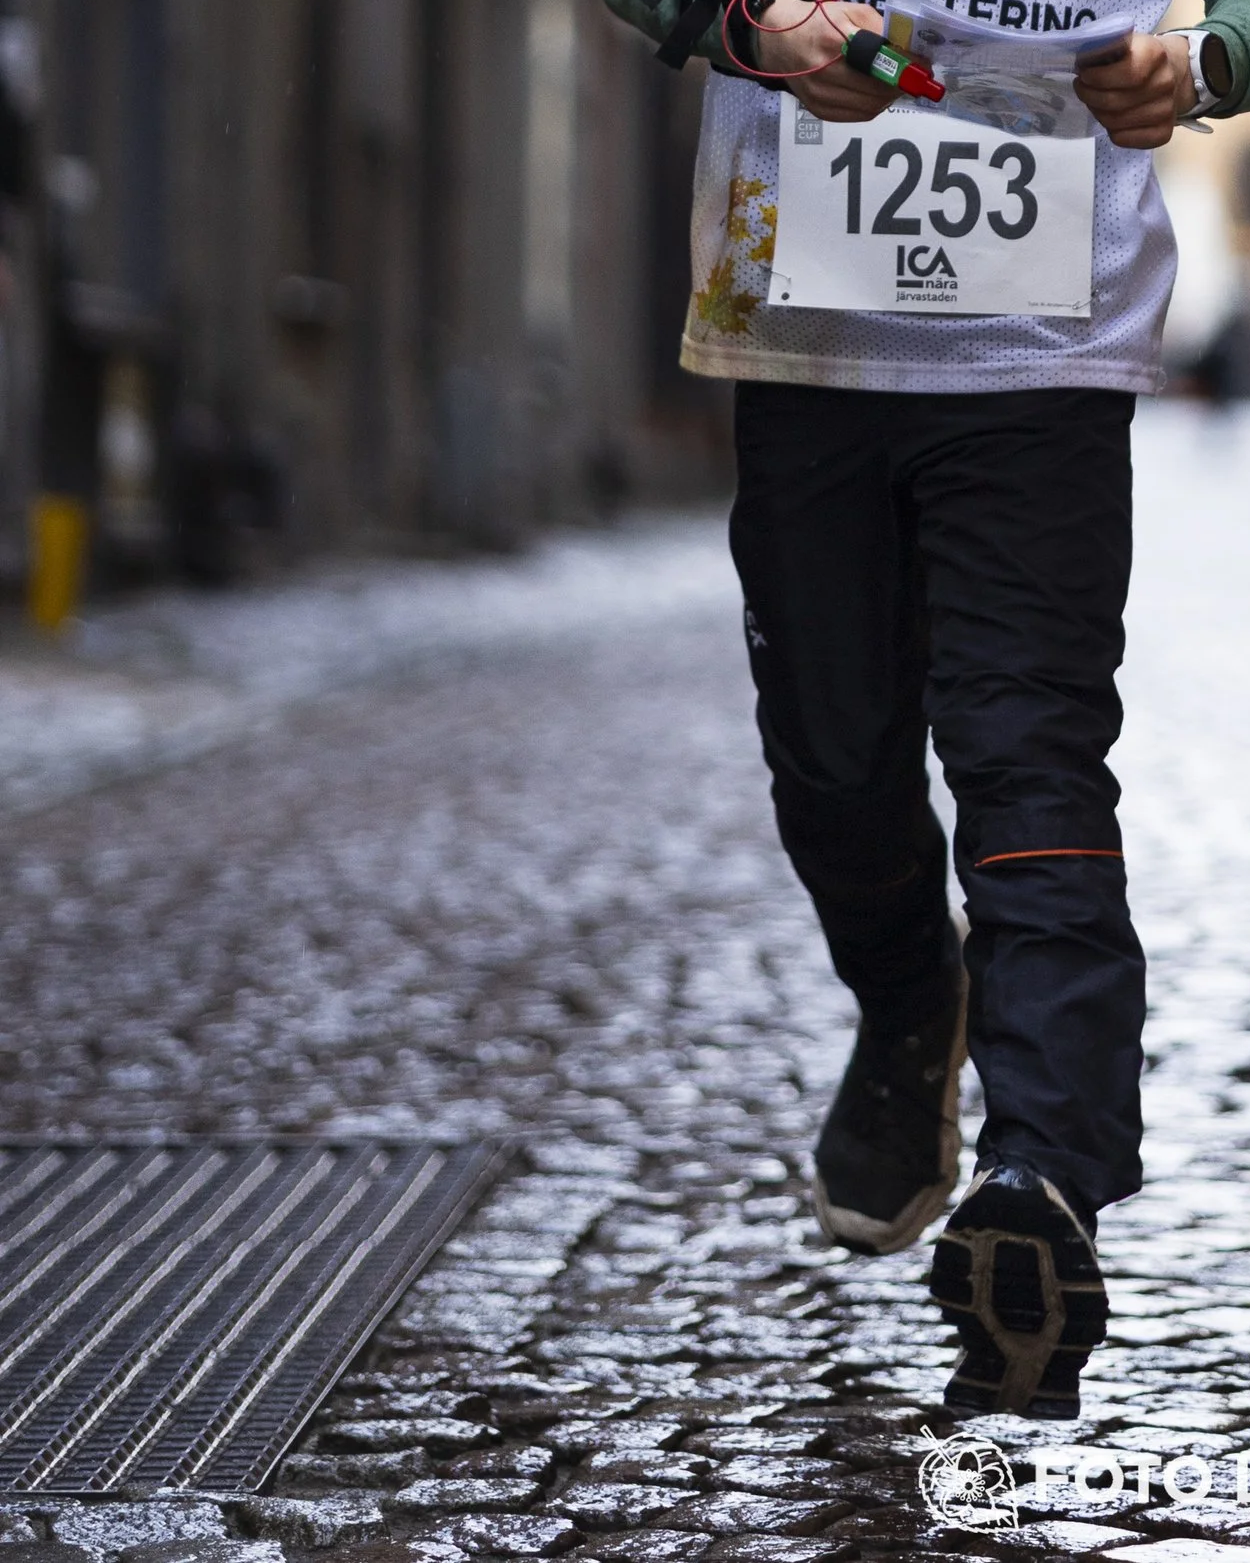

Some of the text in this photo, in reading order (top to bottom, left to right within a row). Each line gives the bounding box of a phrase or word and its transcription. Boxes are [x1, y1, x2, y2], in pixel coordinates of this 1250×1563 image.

[798, 123, 819, 131] CITY
[798, 131, 819, 139] CUP
[831, 137, 1038, 239] 1253
[897, 245, 957, 277] ICA
[925, 278, 958, 289] nära
[896, 291, 958, 302] järvastaden
